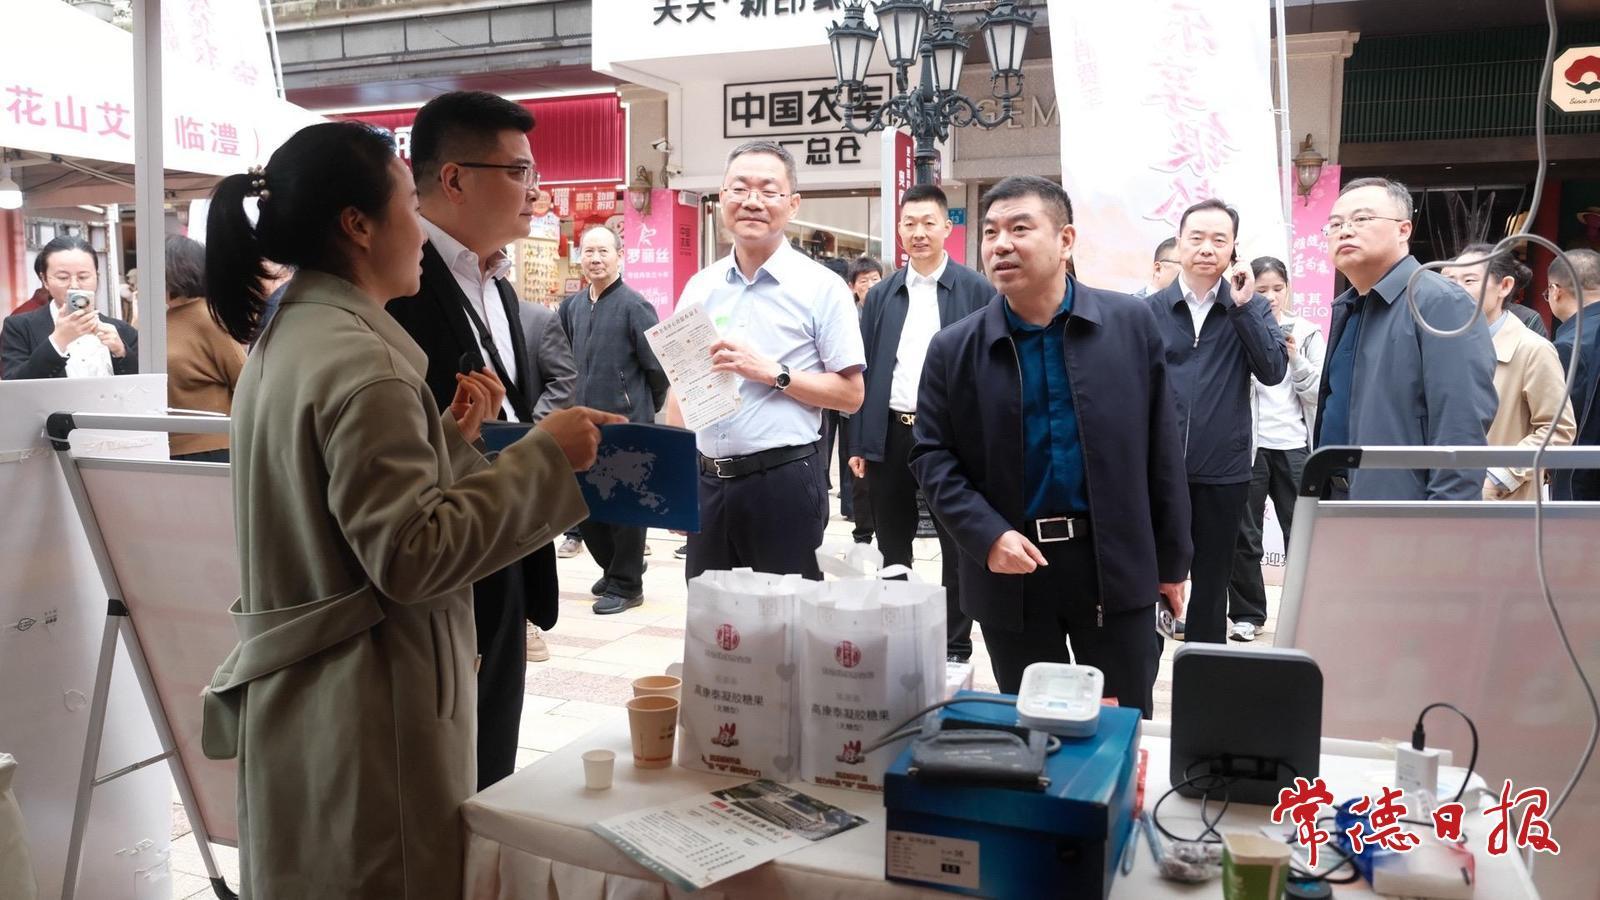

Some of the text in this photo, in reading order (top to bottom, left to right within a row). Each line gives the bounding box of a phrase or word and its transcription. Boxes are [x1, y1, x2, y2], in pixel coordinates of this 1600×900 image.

[6, 84, 131, 141] 花山艾
[731, 87, 883, 128] 中国衣库
[771, 136, 861, 165] 厂总仓
